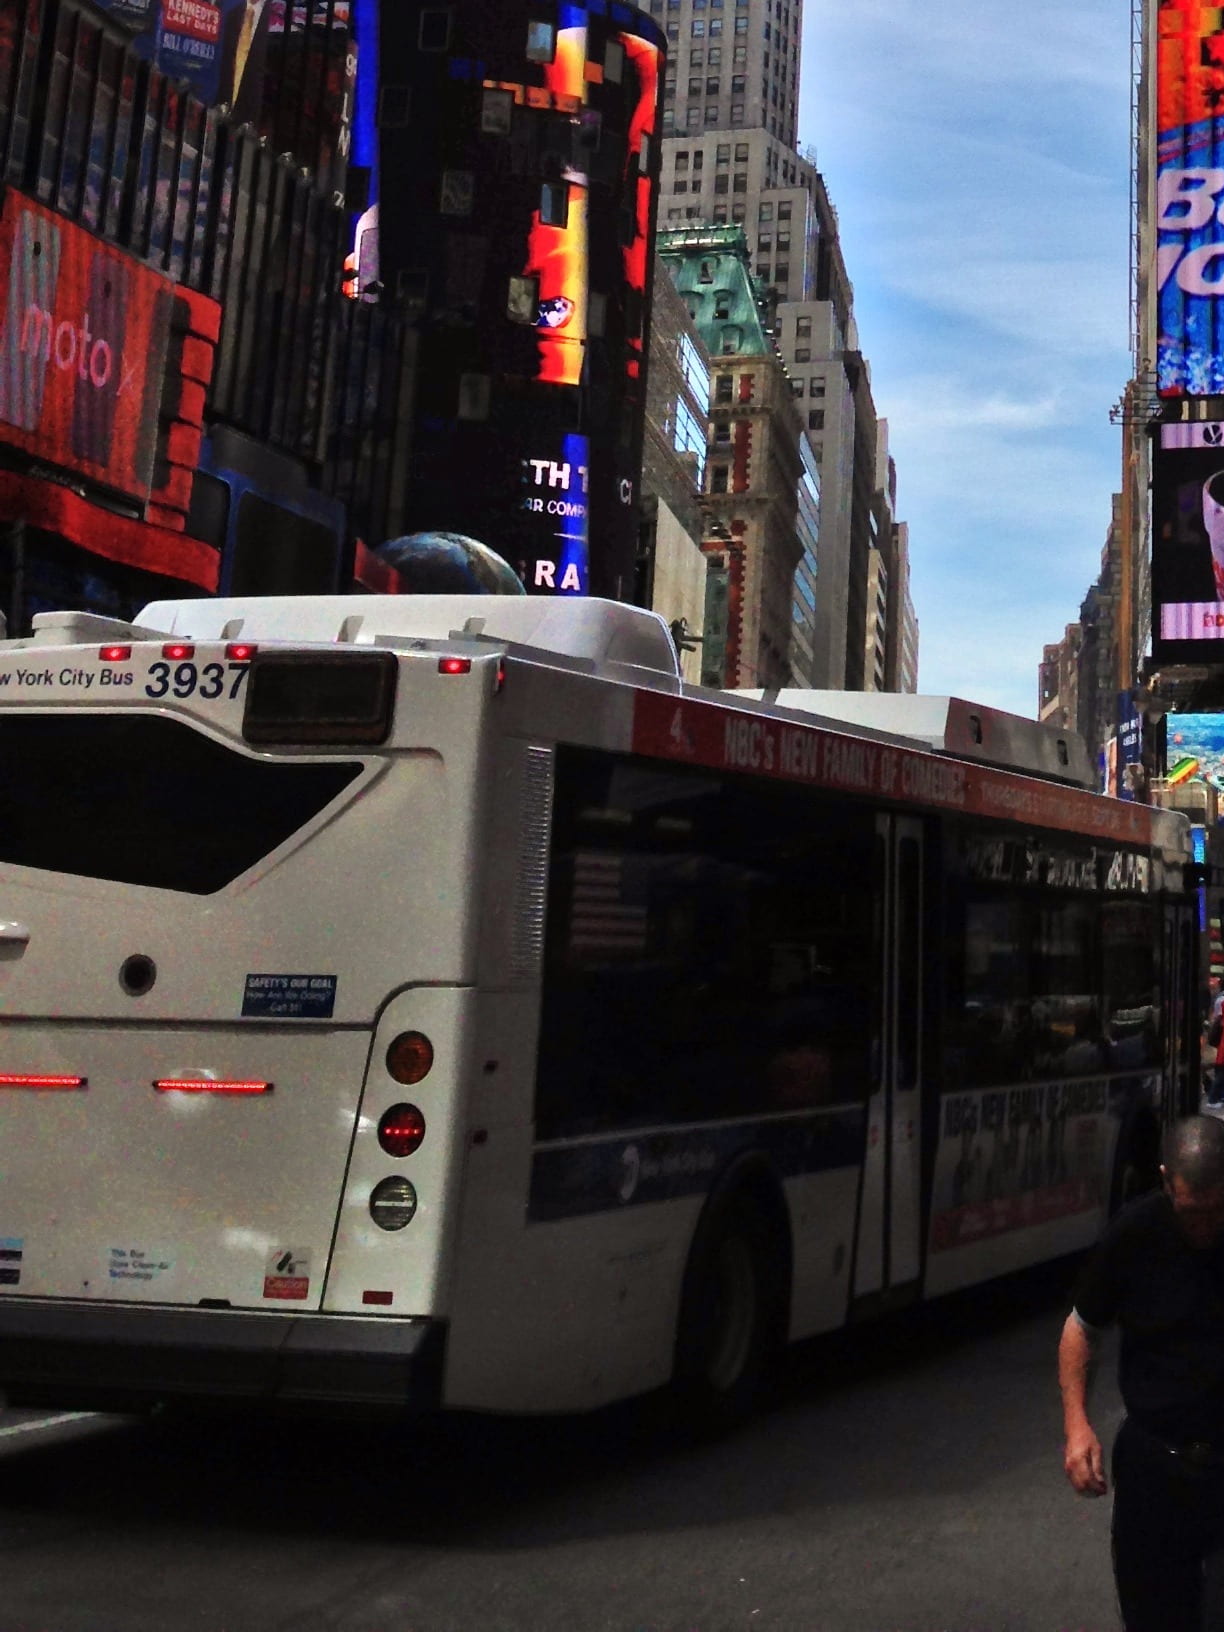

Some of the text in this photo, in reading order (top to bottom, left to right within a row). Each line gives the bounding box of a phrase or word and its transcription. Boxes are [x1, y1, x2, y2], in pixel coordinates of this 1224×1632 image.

[166, 12, 217, 35] LAST DAYS
[20, 304, 112, 388] moto
[547, 500, 587, 518] COMP
[16, 669, 53, 687] York
[60, 669, 95, 689] City
[100, 669, 134, 685] Bus
[145, 662, 249, 700] 3937
[724, 718, 774, 770] NBC's
[780, 726, 817, 778] NEW
[823, 736, 877, 788] FAMILY
[248, 977, 332, 989] SAFETY'S OUR GOAL
